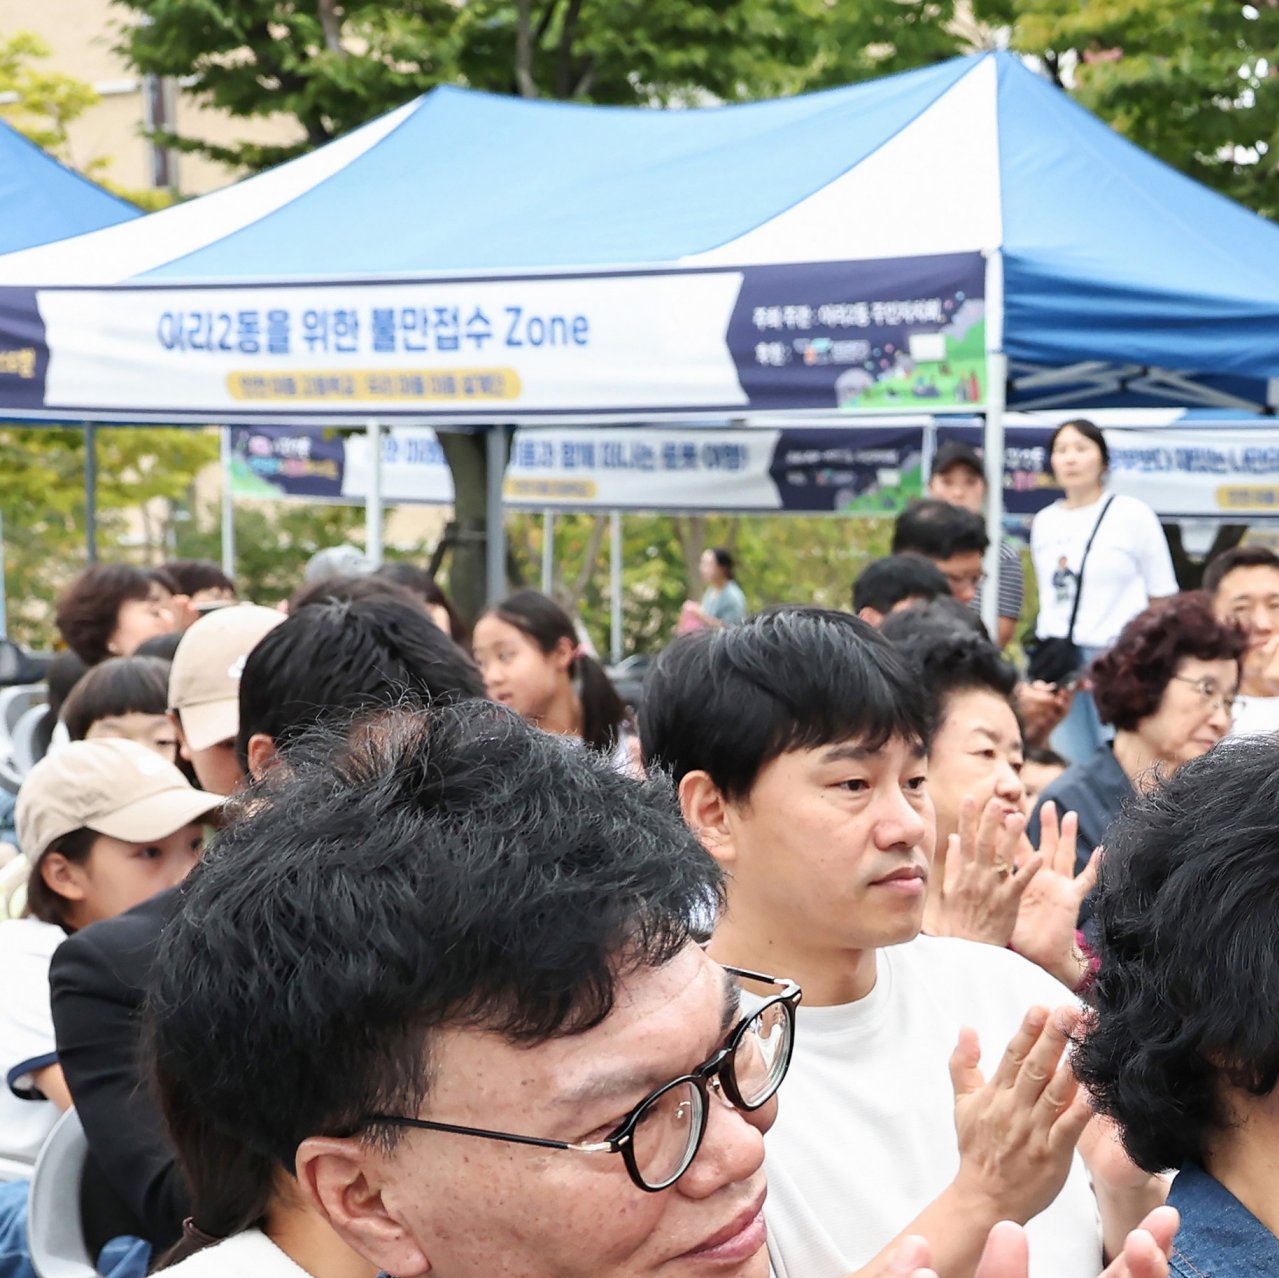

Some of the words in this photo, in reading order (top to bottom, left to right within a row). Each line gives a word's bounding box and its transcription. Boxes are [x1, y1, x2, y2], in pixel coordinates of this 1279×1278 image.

[302, 309, 358, 352] 위한
[372, 306, 493, 353] 불만접수
[505, 305, 589, 347] Zone
